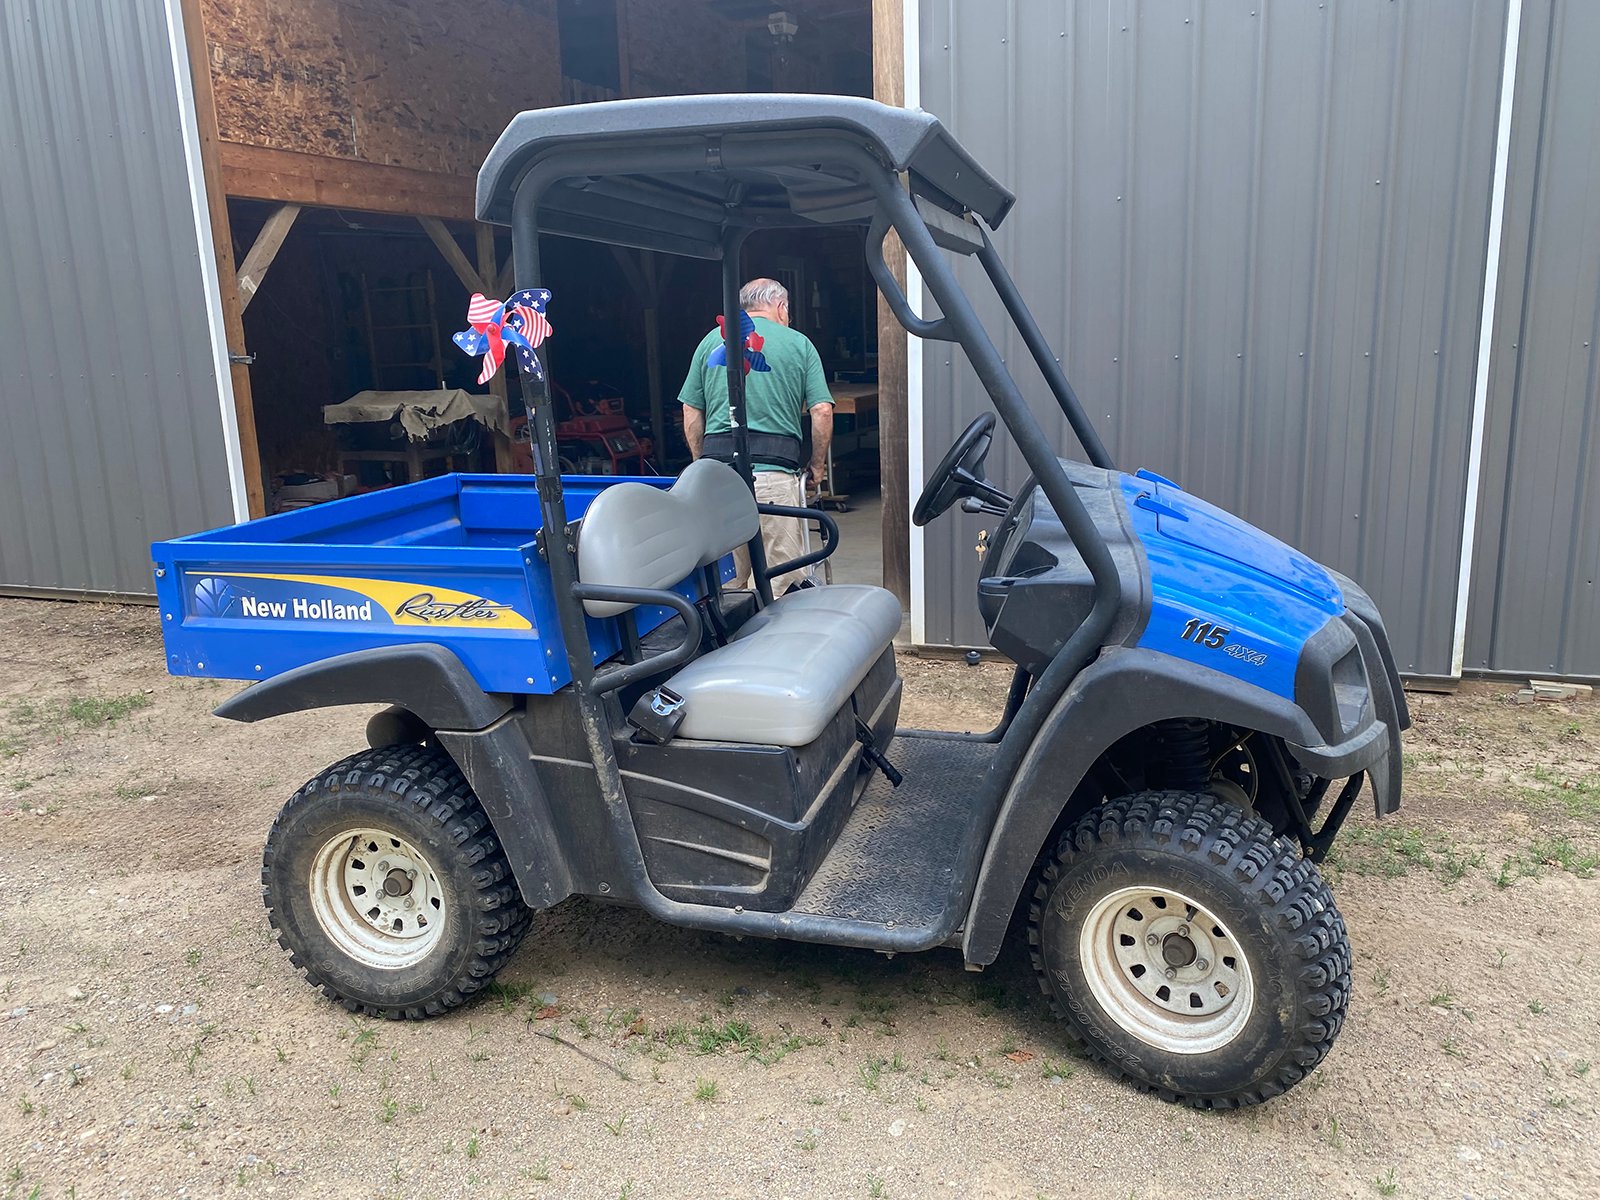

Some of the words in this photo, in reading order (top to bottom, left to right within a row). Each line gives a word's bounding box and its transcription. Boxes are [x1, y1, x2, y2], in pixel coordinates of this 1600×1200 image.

[242, 597, 287, 618] New
[293, 598, 372, 620] Holland
[395, 594, 512, 622] Rustler
[1181, 617, 1230, 649] 115
[1055, 860, 1130, 922] KENDA
